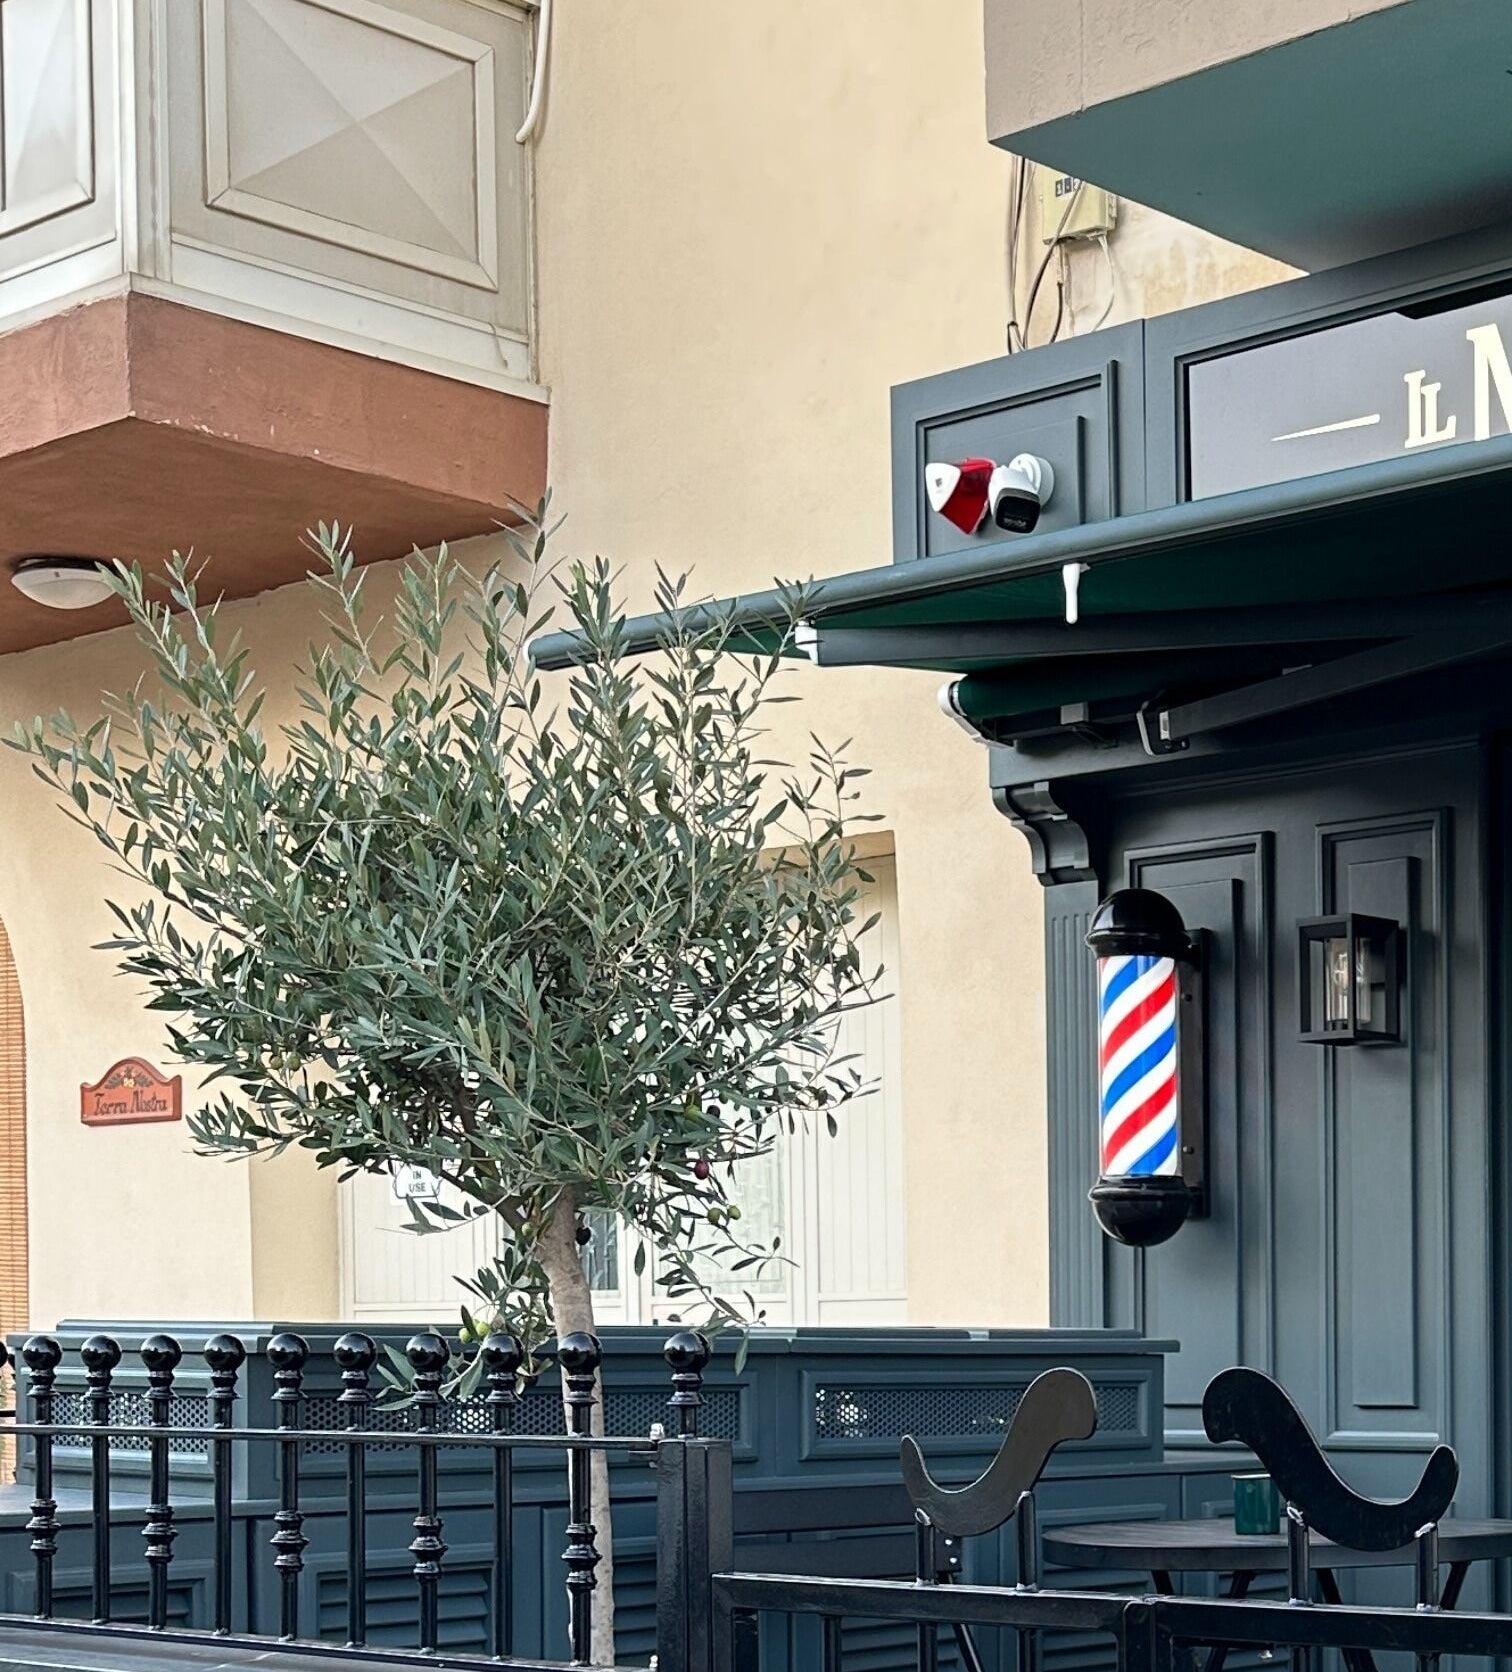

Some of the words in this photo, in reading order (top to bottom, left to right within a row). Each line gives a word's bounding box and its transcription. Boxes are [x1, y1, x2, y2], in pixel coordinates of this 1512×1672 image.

[94, 1093, 128, 1116] Terra
[131, 1090, 168, 1113] Nostra
[412, 1170, 422, 1180] IN
[408, 1182, 426, 1193] USE
